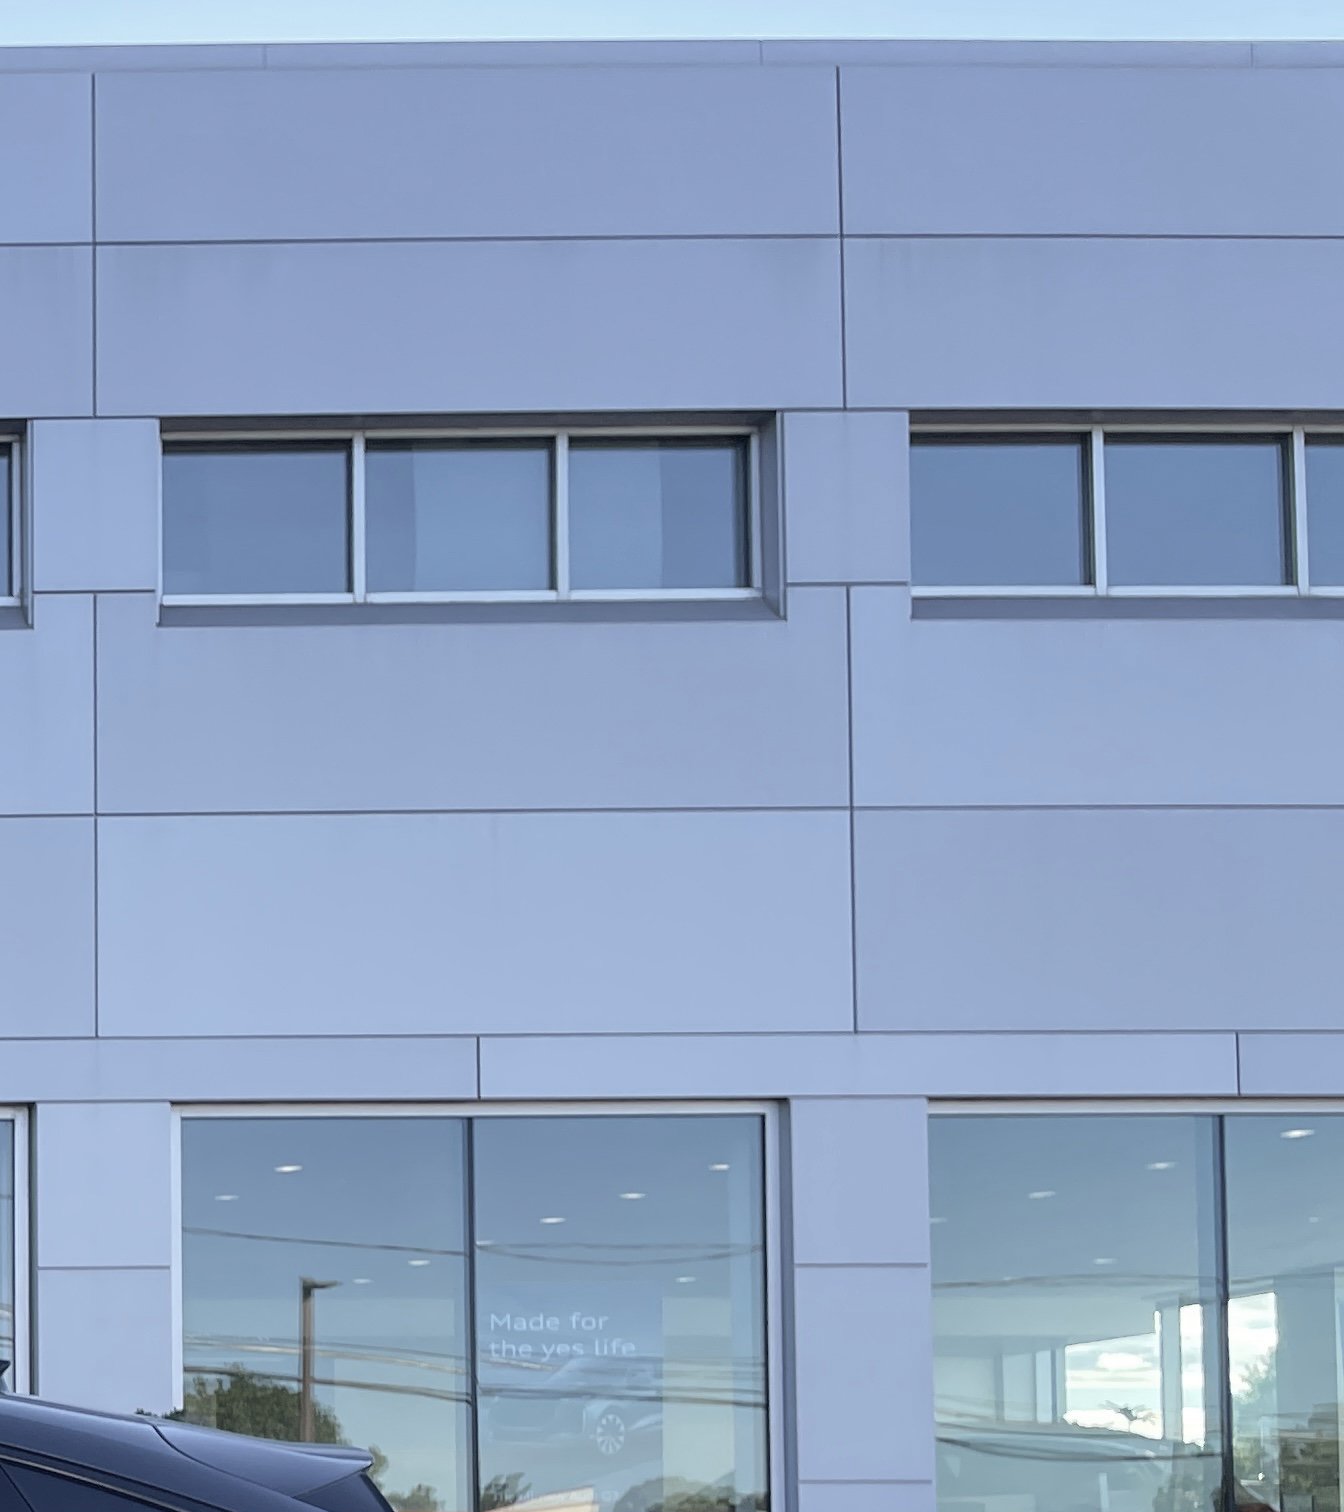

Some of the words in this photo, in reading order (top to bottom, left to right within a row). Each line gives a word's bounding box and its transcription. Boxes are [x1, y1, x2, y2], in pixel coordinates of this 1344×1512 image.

[490, 1313, 559, 1331] Made
[569, 1312, 609, 1331] for
[489, 1339, 533, 1358] the
[541, 1343, 584, 1362] yes
[594, 1338, 636, 1357] life
